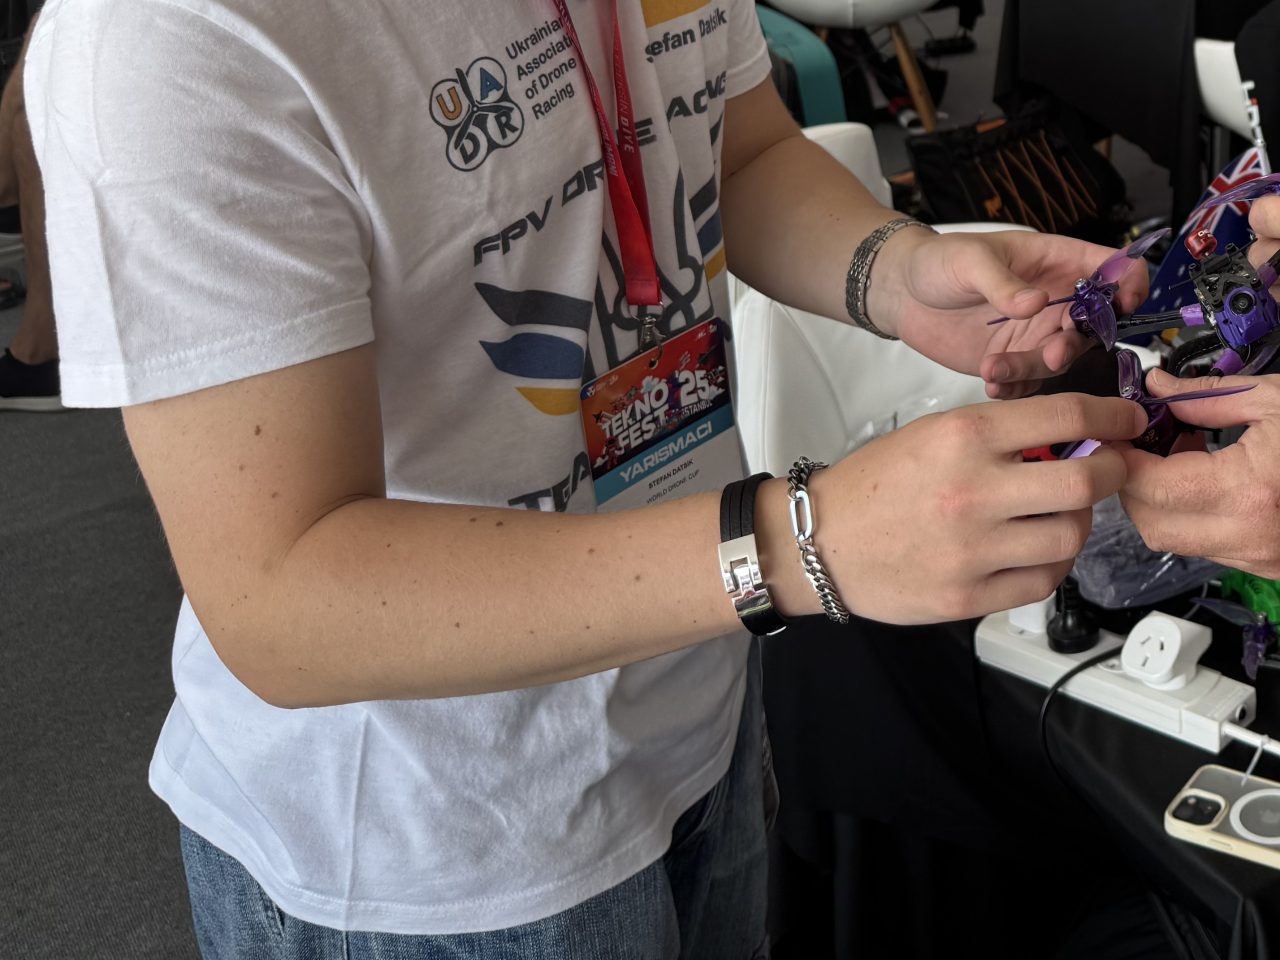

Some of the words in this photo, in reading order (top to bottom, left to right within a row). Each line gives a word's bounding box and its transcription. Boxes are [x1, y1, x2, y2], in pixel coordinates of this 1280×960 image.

[505, 17, 565, 60] Ukrainia
[525, 79, 540, 100] of
[539, 56, 577, 90] Drone
[531, 83, 575, 120] Racing
[474, 195, 553, 267] FPV
[601, 379, 669, 438] TEKNO
[648, 471, 672, 489] STEFAN
